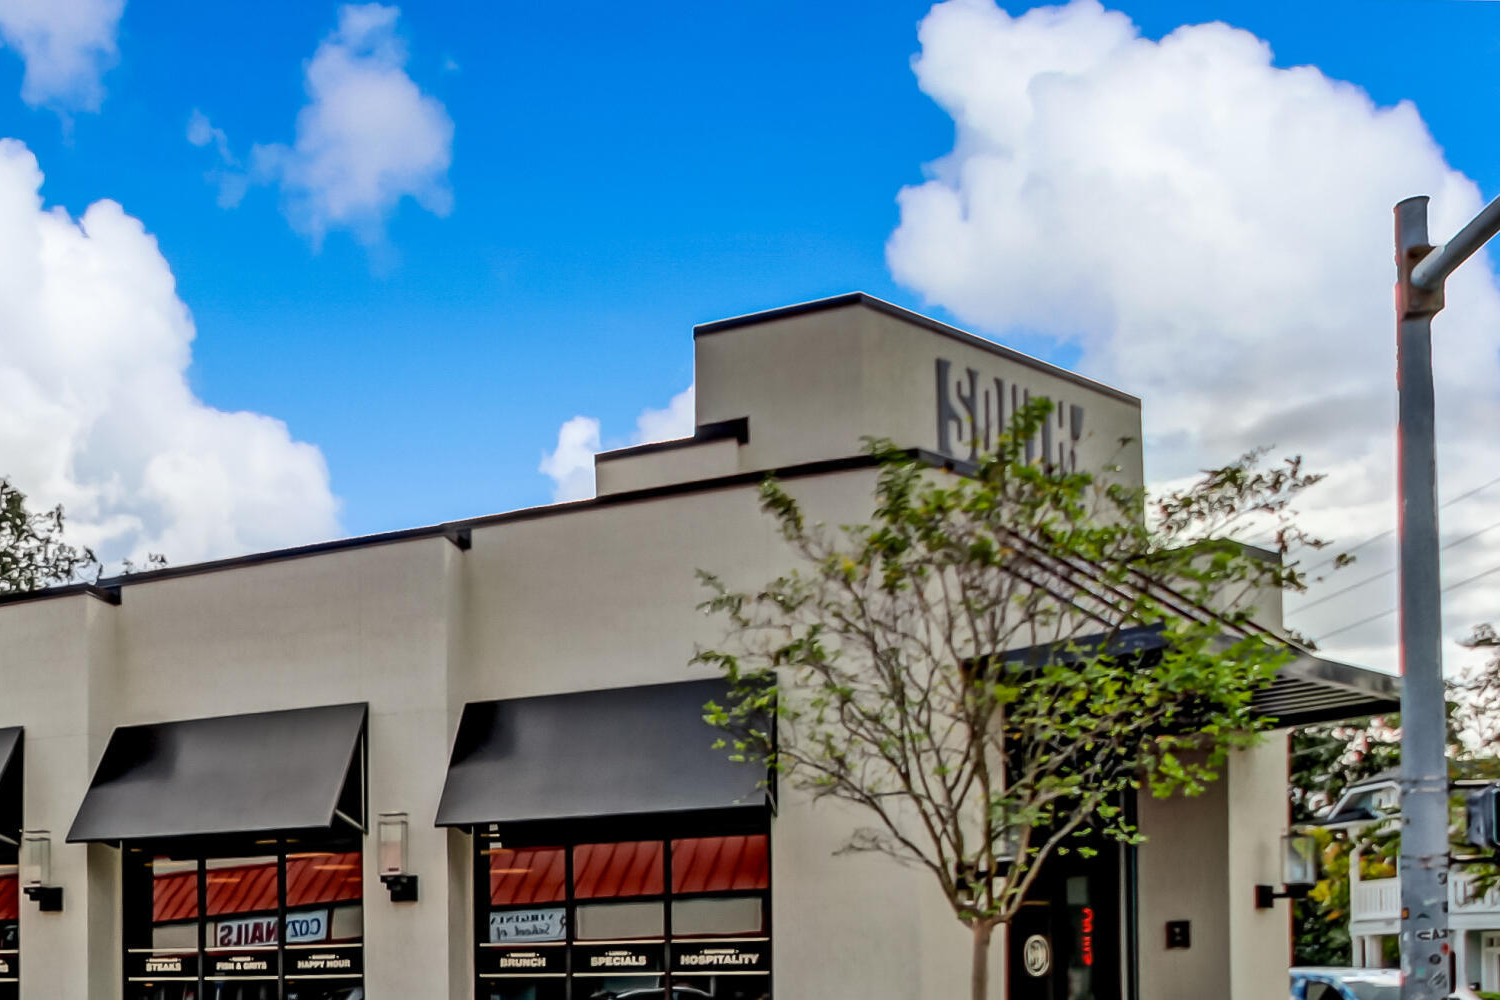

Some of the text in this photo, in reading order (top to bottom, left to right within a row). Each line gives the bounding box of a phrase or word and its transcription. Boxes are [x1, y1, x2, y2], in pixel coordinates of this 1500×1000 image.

[297, 959, 351, 969] HAPPY HOUR
[500, 957, 546, 968] BRUNCH
[591, 955, 647, 967] SPECIALS
[680, 953, 760, 965] HOSPITALITY
[146, 963, 182, 972] STEAKS
